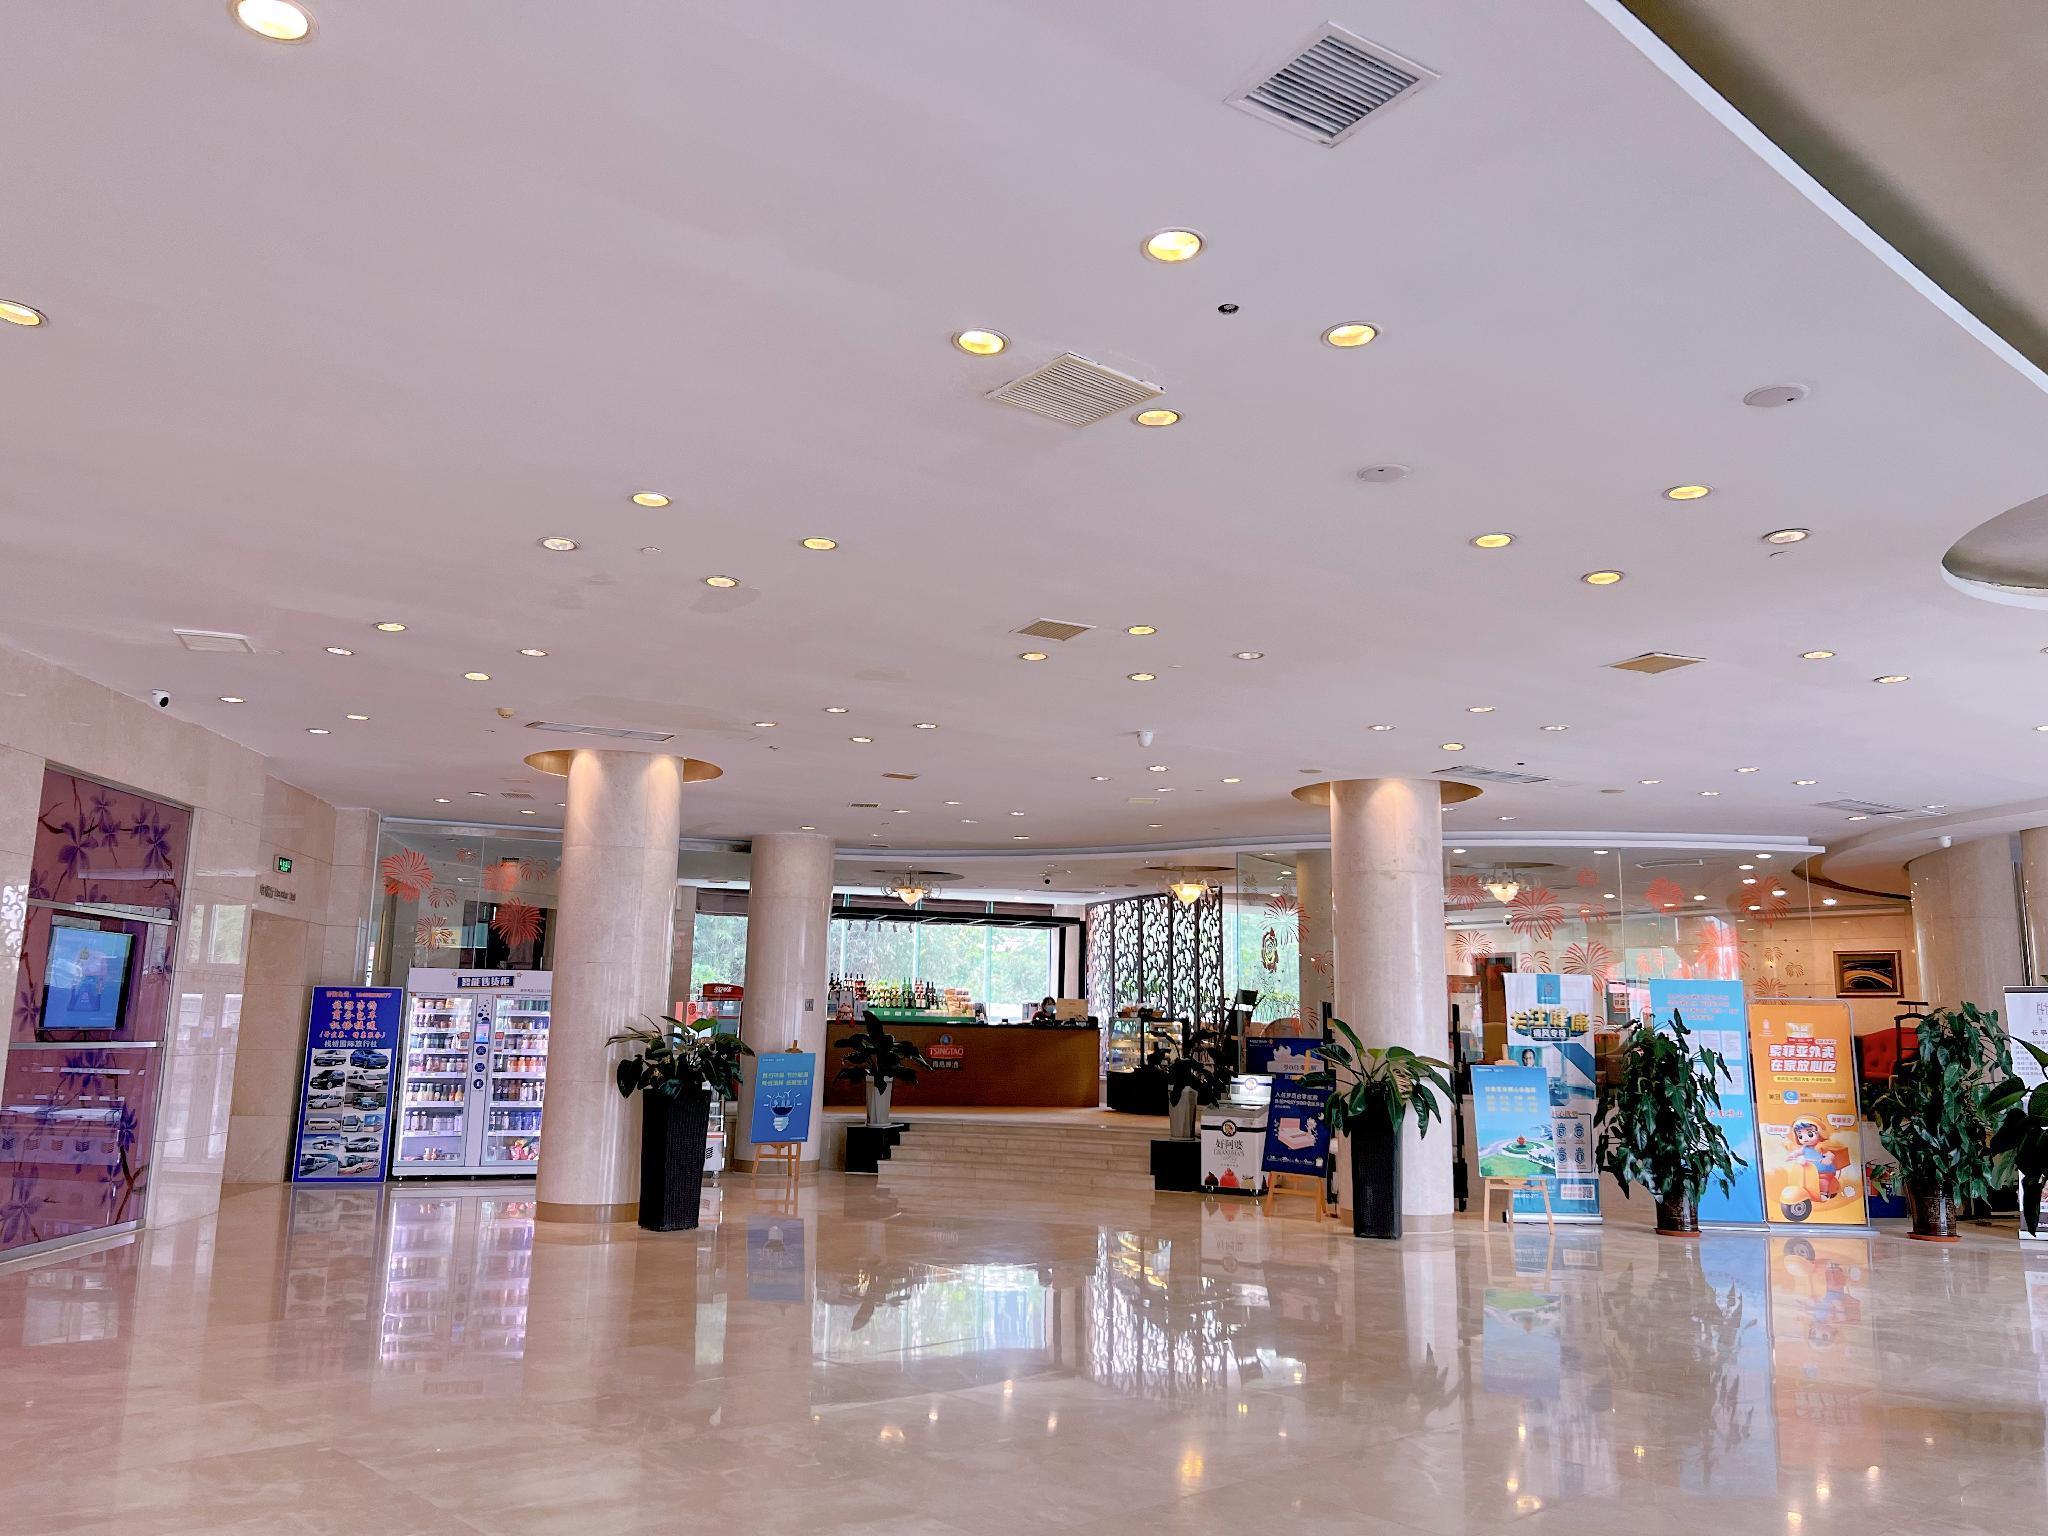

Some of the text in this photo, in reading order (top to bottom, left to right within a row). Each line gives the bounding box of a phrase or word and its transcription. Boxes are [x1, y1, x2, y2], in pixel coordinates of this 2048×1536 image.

[461, 977, 510, 987] 智能售货柜
[1510, 1006, 1590, 1032] 关注健康
[324, 1040, 378, 1048] 栈桥国际旅行社
[929, 1047, 964, 1056] TSINGTAO
[1768, 1044, 1836, 1059] 索菲亚外卖
[1770, 1059, 1837, 1073] 在家放心吃
